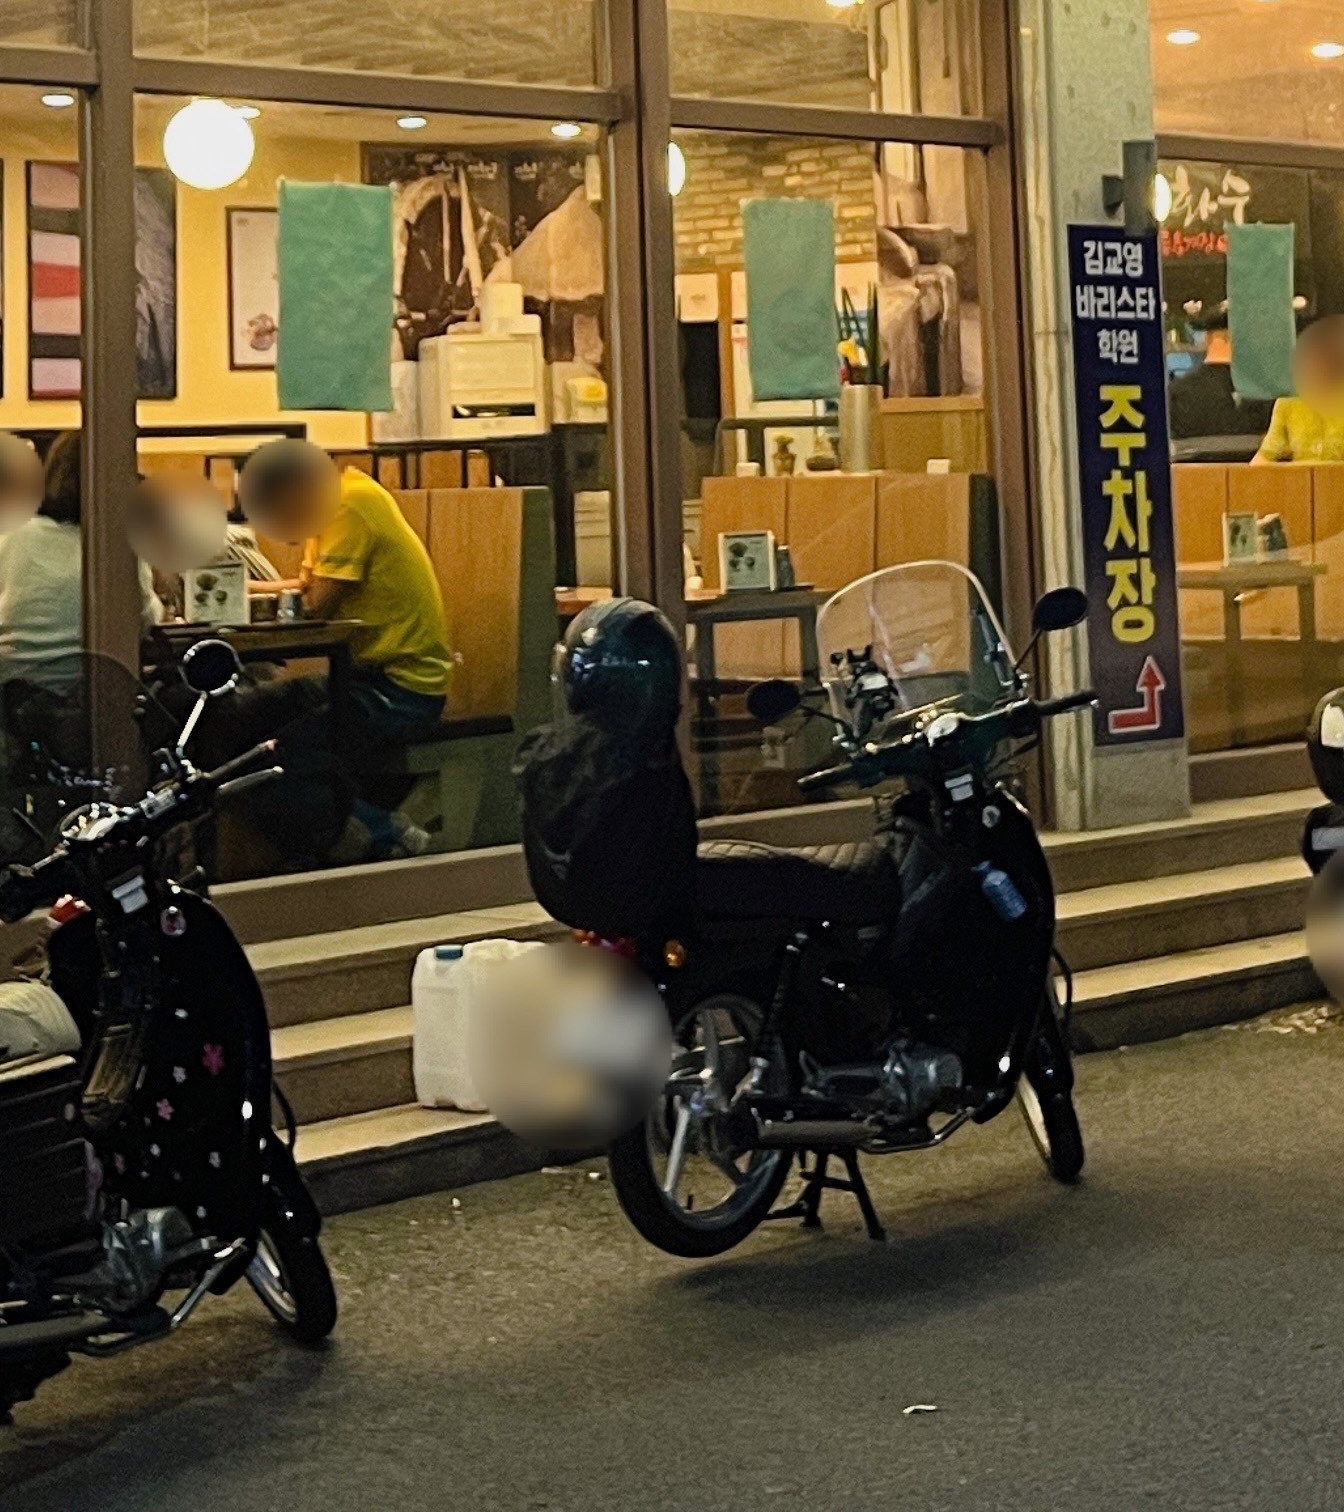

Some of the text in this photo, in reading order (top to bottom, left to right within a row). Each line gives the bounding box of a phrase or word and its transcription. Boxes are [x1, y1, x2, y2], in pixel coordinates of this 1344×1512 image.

[1083, 240, 1144, 277] 김교영
[1075, 284, 1156, 320] 바리스타
[1097, 328, 1139, 365] 학원
[1099, 384, 1158, 644] 주차장
